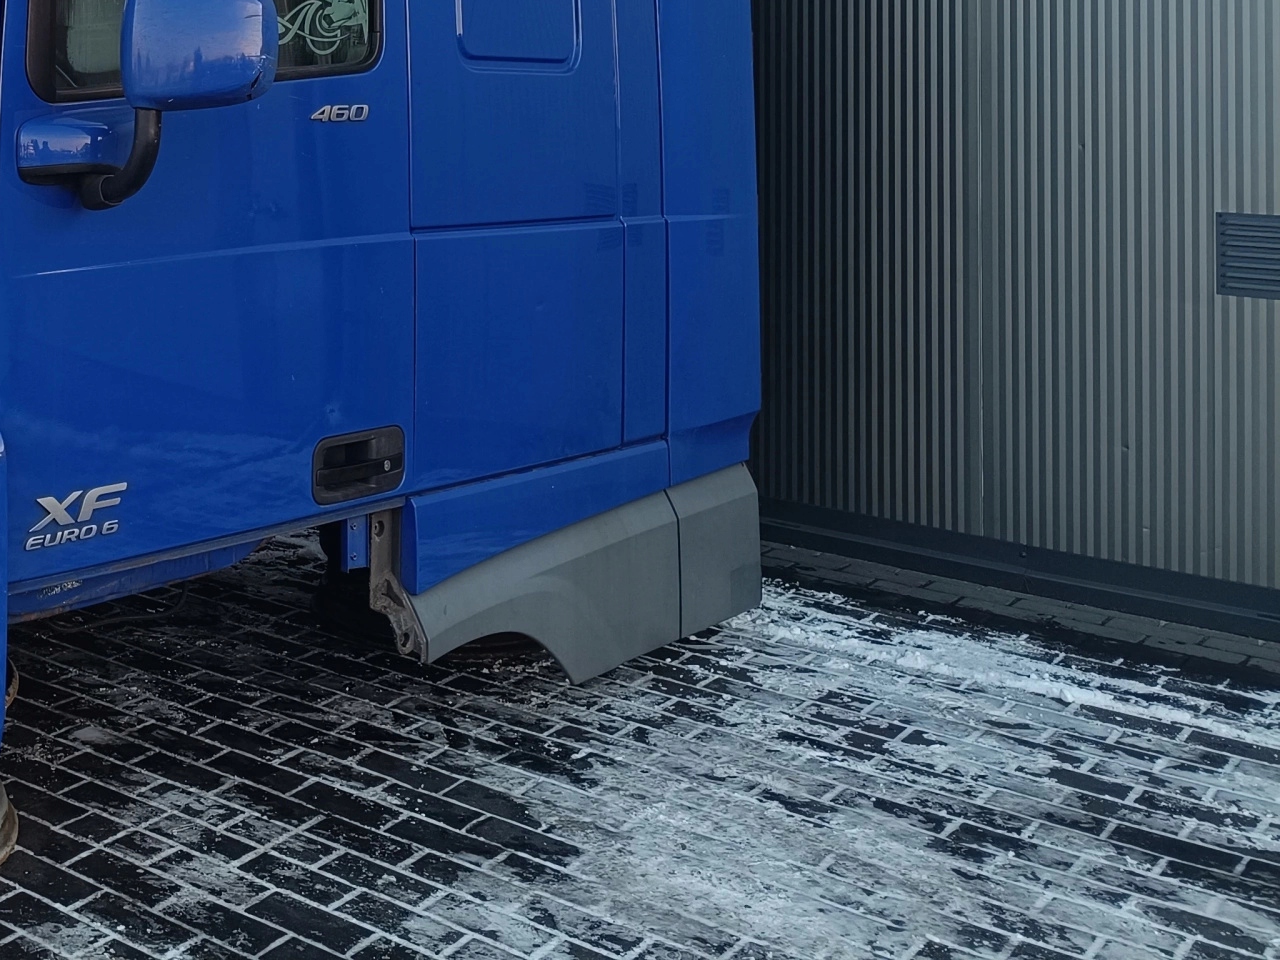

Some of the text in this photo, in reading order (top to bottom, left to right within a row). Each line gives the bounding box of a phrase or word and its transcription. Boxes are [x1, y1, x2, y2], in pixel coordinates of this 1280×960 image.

[310, 104, 369, 122] 460
[28, 482, 128, 532] XF
[25, 519, 119, 551] EURO 6
